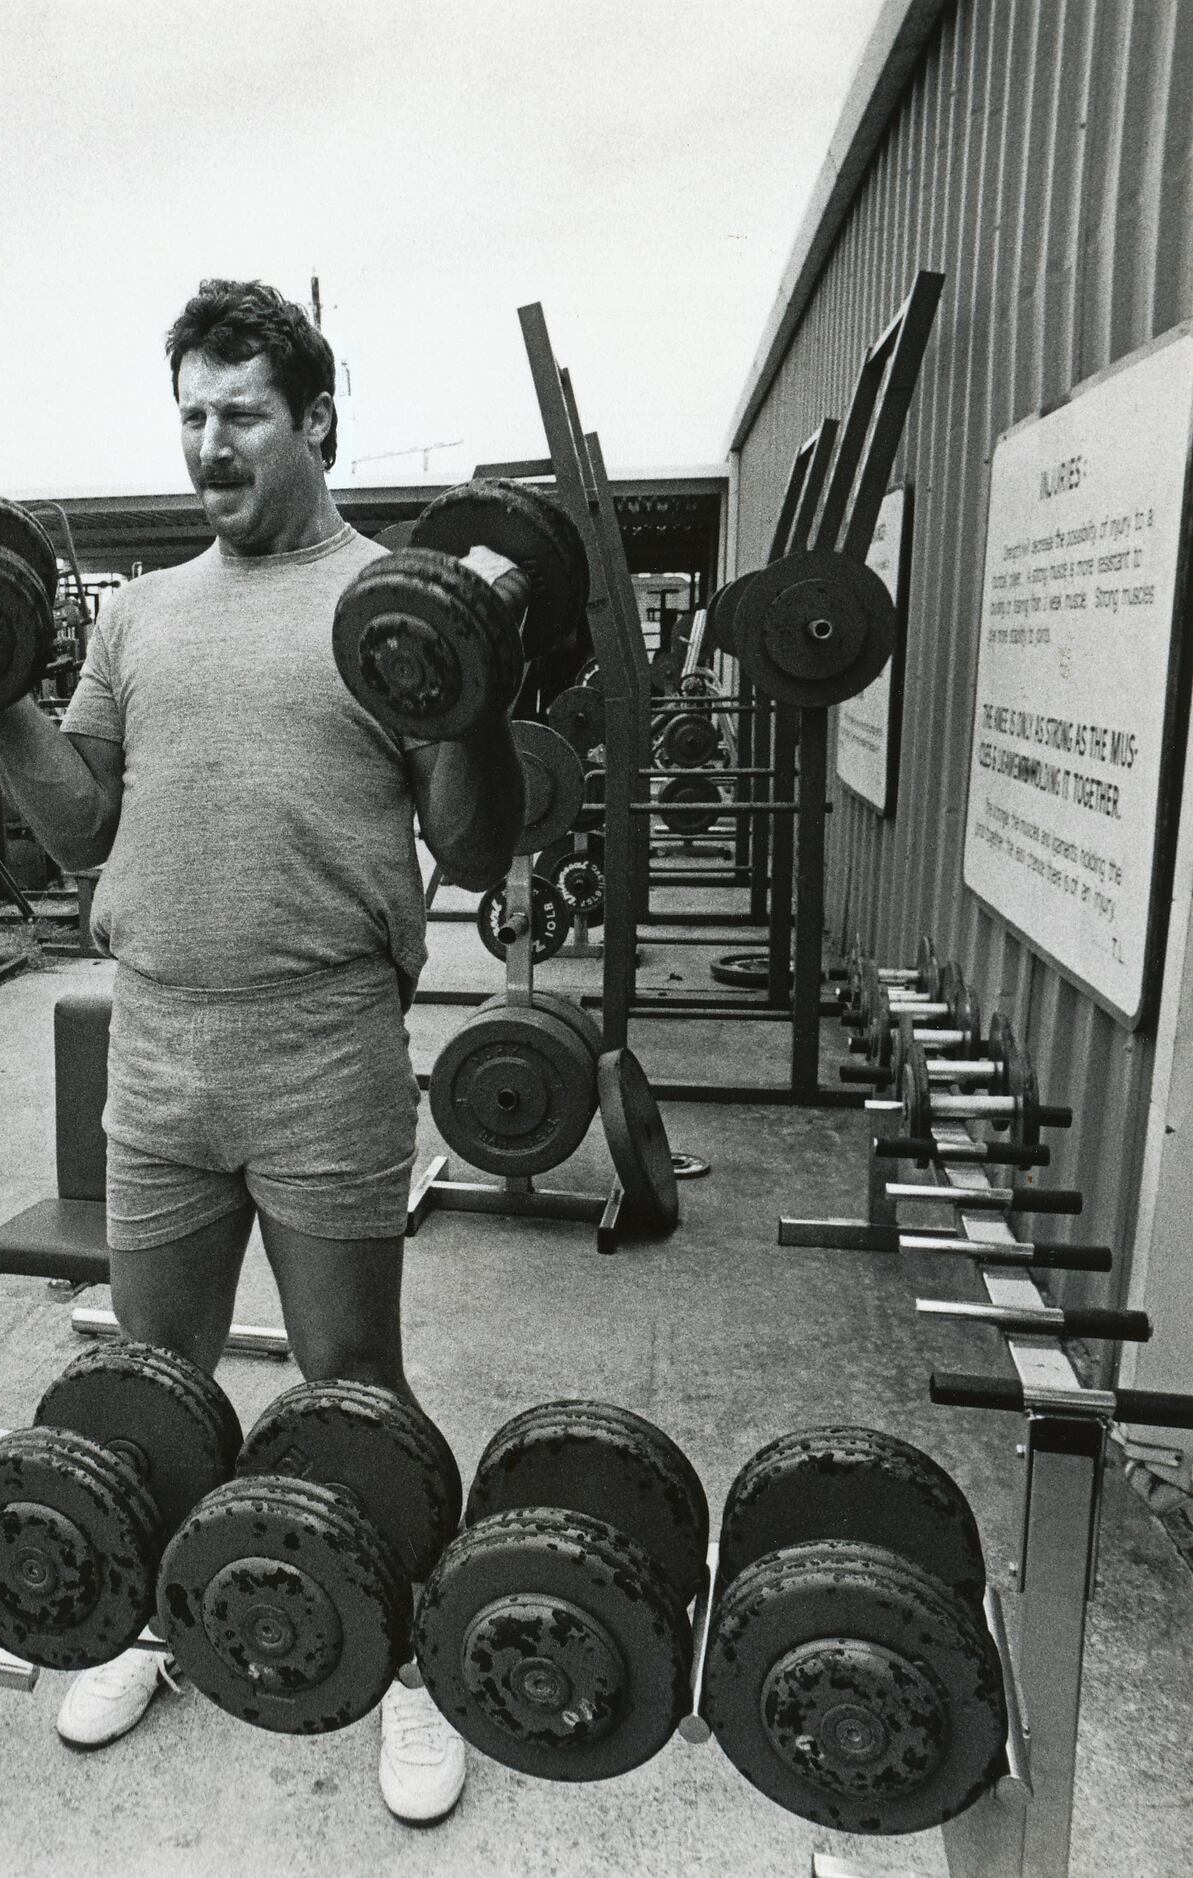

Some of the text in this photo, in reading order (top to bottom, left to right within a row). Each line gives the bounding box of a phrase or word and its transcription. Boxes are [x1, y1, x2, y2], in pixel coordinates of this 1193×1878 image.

[1110, 516, 1131, 541] injury
[1134, 512, 1144, 531] to
[1095, 586, 1119, 614] Strong
[1122, 584, 1155, 606] muscles
[1075, 724, 1088, 757] AS
[1089, 725, 1108, 762] THE
[1110, 730, 1138, 769] MUS-
[1073, 772, 1121, 820] TOGETHER.
[1109, 861, 1122, 886] the
[1081, 883, 1091, 902] an
